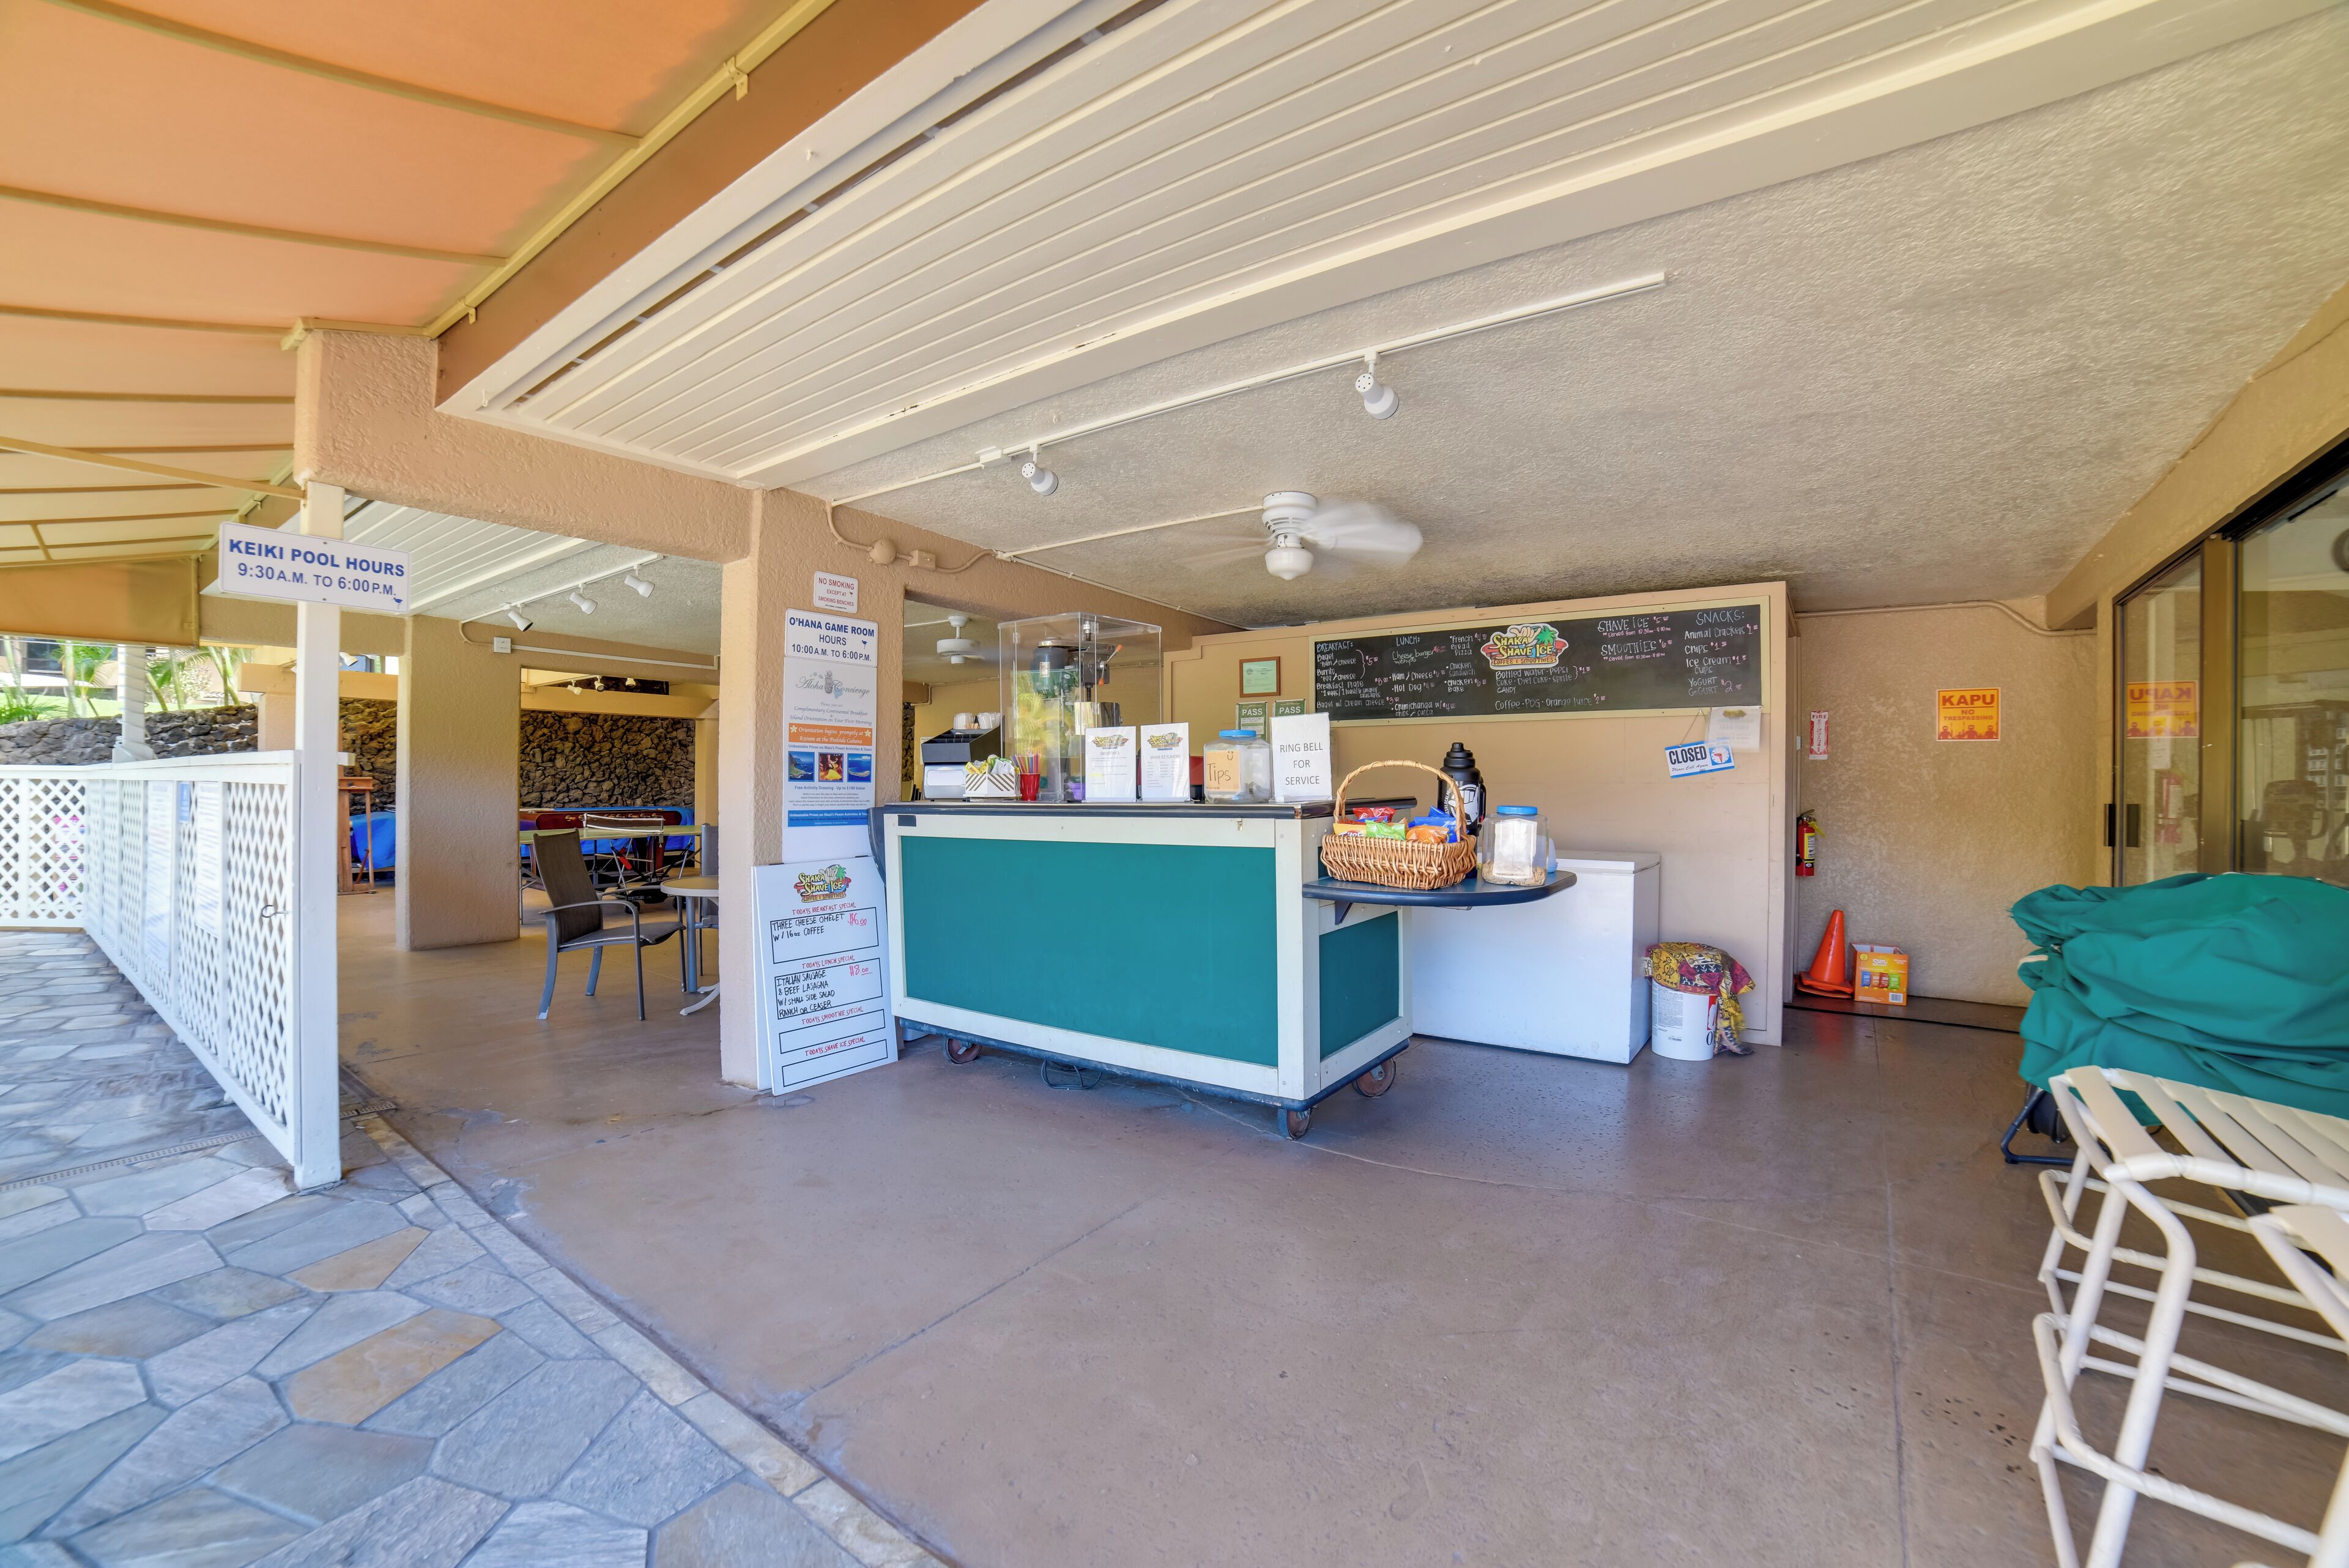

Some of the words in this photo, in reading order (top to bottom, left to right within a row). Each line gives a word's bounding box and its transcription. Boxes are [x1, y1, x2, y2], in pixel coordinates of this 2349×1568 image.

[229, 539, 283, 559] KEIKI
[291, 548, 340, 568] POOL
[346, 557, 404, 577] HOURS
[313, 574, 332, 587] TO
[829, 579, 854, 590] SMOKING
[1696, 609, 1745, 625] SNACKS:
[789, 617, 822, 630] O'HANA
[825, 622, 848, 633] GAME
[851, 626, 874, 637] ROOM
[1597, 619, 1629, 632] SHAVE
[819, 634, 847, 645] HOURS
[1684, 628, 1711, 640] Animal
[1714, 626, 1745, 637] Crackers
[1490, 635, 1528, 649] SHAKA
[1317, 652, 1334, 662] Bagel
[1496, 645, 1532, 659] SHAVE
[1537, 644, 1554, 656] ICE
[1450, 662, 1472, 671] Chicken
[1686, 658, 1699, 667] Ice
[1703, 656, 1731, 666] Cream
[1317, 667, 1335, 676] Burrito
[1392, 673, 1405, 682] Ham
[1411, 672, 1433, 681] Cheese
[1496, 669, 1521, 680] Bottled
[796, 676, 824, 690] Aloha
[832, 680, 870, 698] Concierge
[1316, 682, 1344, 690] Breakfast
[1518, 677, 1532, 685] Diet
[1394, 684, 1405, 693] Hot
[1409, 683, 1422, 693] Dog
[1495, 699, 1521, 710] Coffee
[1525, 698, 1540, 708] POG
[1546, 697, 1571, 707] Orange
[1942, 693, 1995, 707] KAPU
[1280, 743, 1301, 753] RING
[1304, 741, 1323, 751] BELL
[1668, 746, 1707, 765] CLOSED
[1293, 760, 1310, 768] FOR
[1207, 763, 1231, 785] Tips
[1285, 776, 1320, 786] SERVICE
[796, 872, 825, 886] SHAKA
[801, 882, 828, 896] SHAVE
[831, 882, 842, 893] ICE
[812, 904, 838, 913] BREAKFAST
[839, 902, 856, 910] SPECIAL
[772, 920, 793, 931] THREE
[795, 917, 817, 927] CHEESE
[819, 913, 845, 923] OMELET
[803, 926, 825, 936] COFFEE
[822, 956, 837, 966] LUNCH
[837, 955, 855, 964] SPECIAL
[776, 975, 801, 987] ITALIAN
[802, 970, 826, 981] SAUSAGE
[784, 986, 800, 995] BEEF
[803, 980, 829, 993] LASAGNA
[788, 996, 804, 1005] SMALL
[806, 992, 817, 1001] SIDE
[818, 990, 835, 998] SALAD
[779, 1007, 798, 1018] RANCH
[809, 1000, 832, 1011] CEASER
[821, 1010, 845, 1020] SMOOTHIE
[845, 1006, 864, 1016] SPECIAL
[824, 1042, 838, 1053] SHAVE
[847, 1036, 866, 1046] SPECIAL
